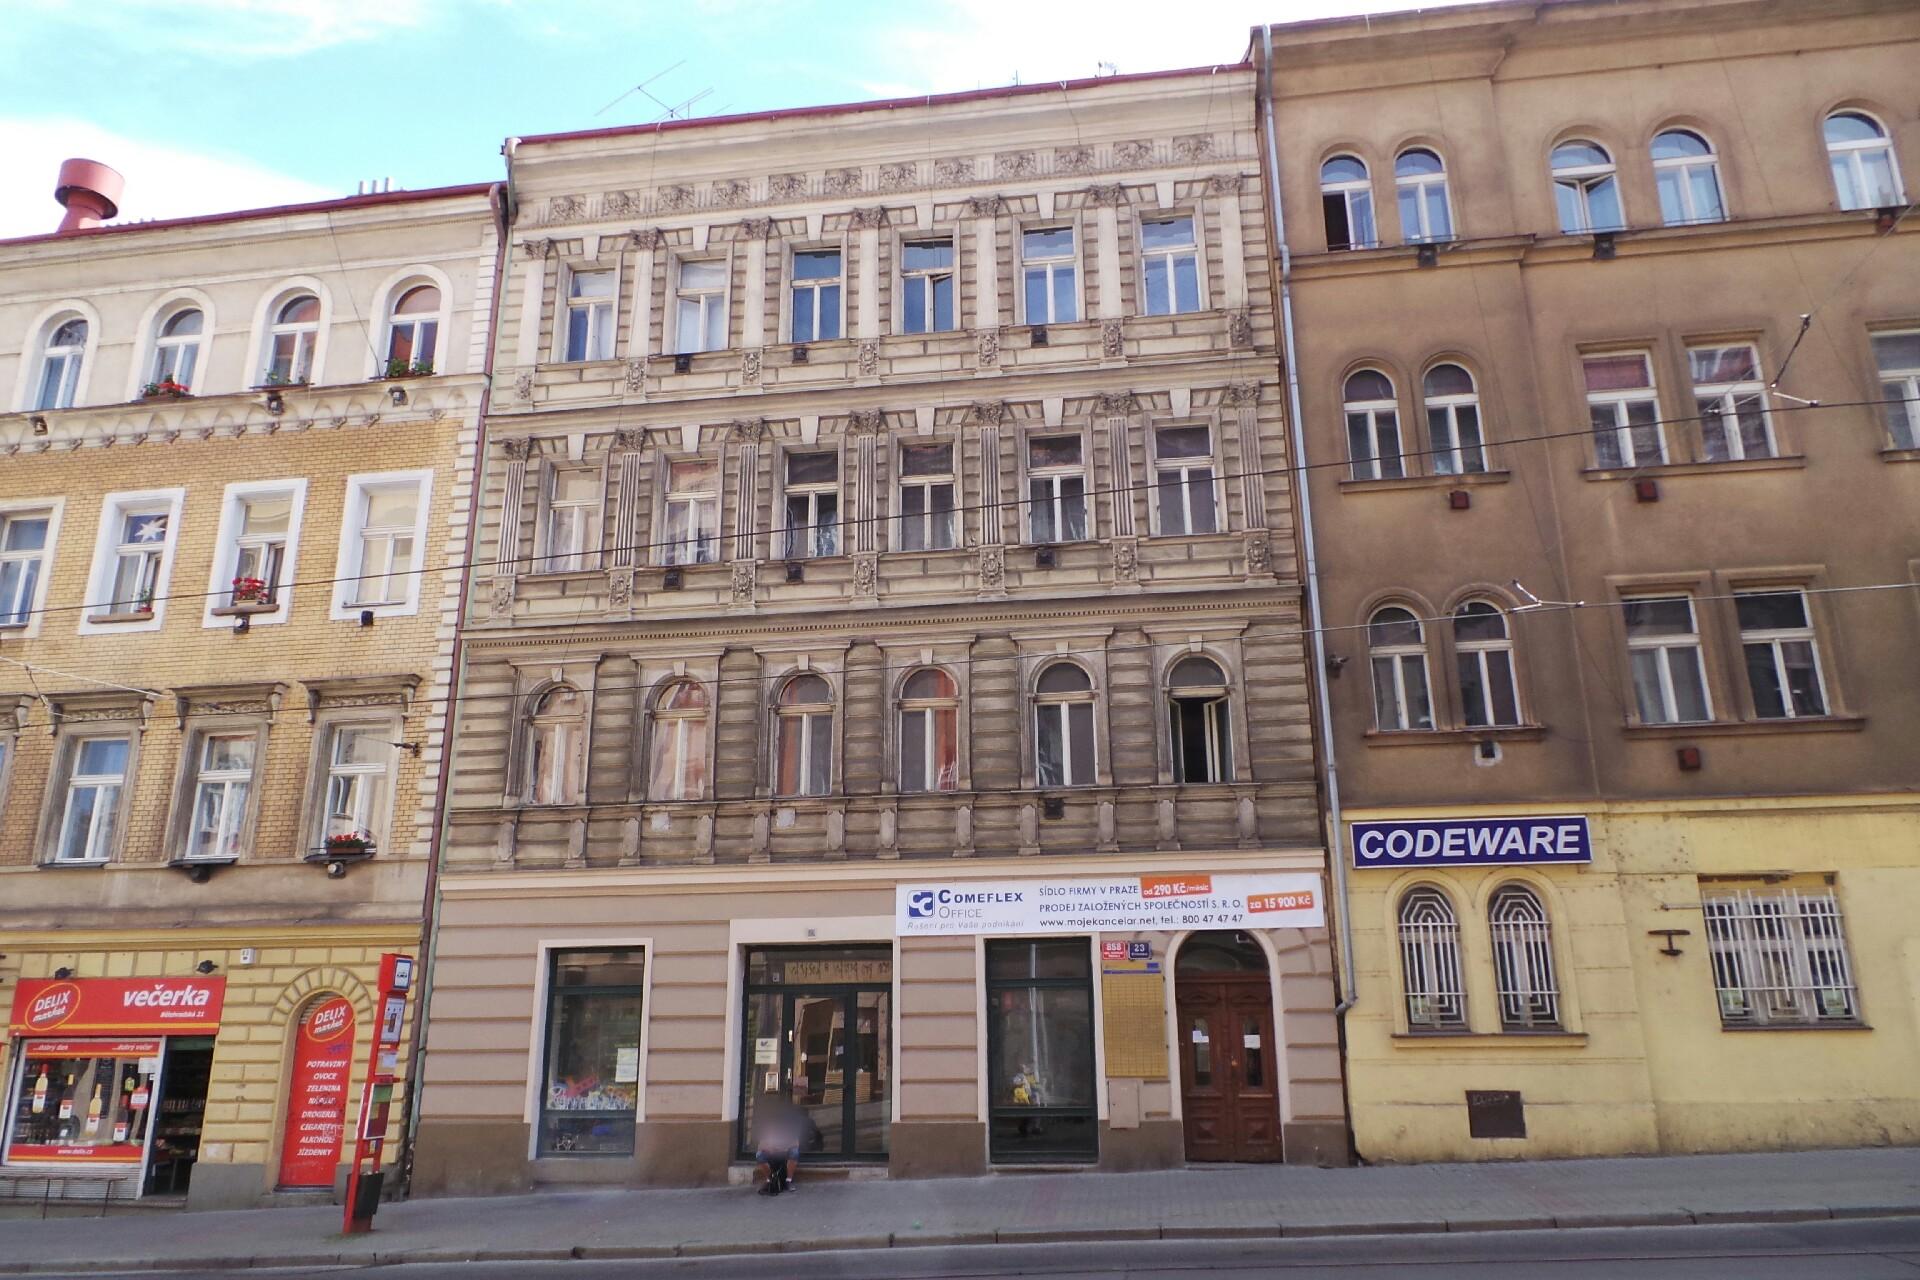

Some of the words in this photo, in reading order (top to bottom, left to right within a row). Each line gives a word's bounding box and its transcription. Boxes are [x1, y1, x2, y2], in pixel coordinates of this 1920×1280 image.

[1359, 825, 1581, 859] CODEWARE
[938, 889, 1024, 904] COMEFLEX
[1039, 885, 1066, 897] SÍDLO
[1069, 886, 1097, 896] FIRMY
[1099, 886, 1107, 896] V
[1109, 885, 1139, 896] PRAZE
[1143, 888, 1153, 896] od
[1153, 884, 1172, 896] 290
[1039, 902, 1076, 913] PRODEJ
[1078, 899, 1141, 912] ZALOŽENÝCH
[1144, 897, 1209, 911] SPOLEČNOSTÍ
[1211, 899, 1220, 910] S.
[1222, 899, 1231, 909] R.
[1233, 899, 1244, 909] O.
[1250, 901, 1261, 909] za
[1264, 898, 1276, 908] 15
[1277, 897, 1297, 908] 900
[1299, 893, 1312, 906] Kč
[939, 906, 983, 919] OFFICE
[1161, 915, 1179, 925] tel.:
[1182, 914, 1200, 924] 800
[1202, 914, 1214, 923] 47
[1217, 914, 1229, 923] 47
[1232, 914, 1243, 923] 47
[1134, 943, 1145, 952] 23
[34, 990, 72, 1012] DELIX
[123, 984, 210, 1007] večerka
[32, 1005, 67, 1023] market
[314, 1005, 347, 1025] DELIX
[313, 1019, 344, 1034] market
[306, 1060, 348, 1069] POTRAVINY
[313, 1072, 338, 1080] OVOCE
[306, 1084, 341, 1092] ZELENINA
[300, 1136, 335, 1144] ALKOHOL
[297, 1147, 333, 1156] JÍZDENKY
